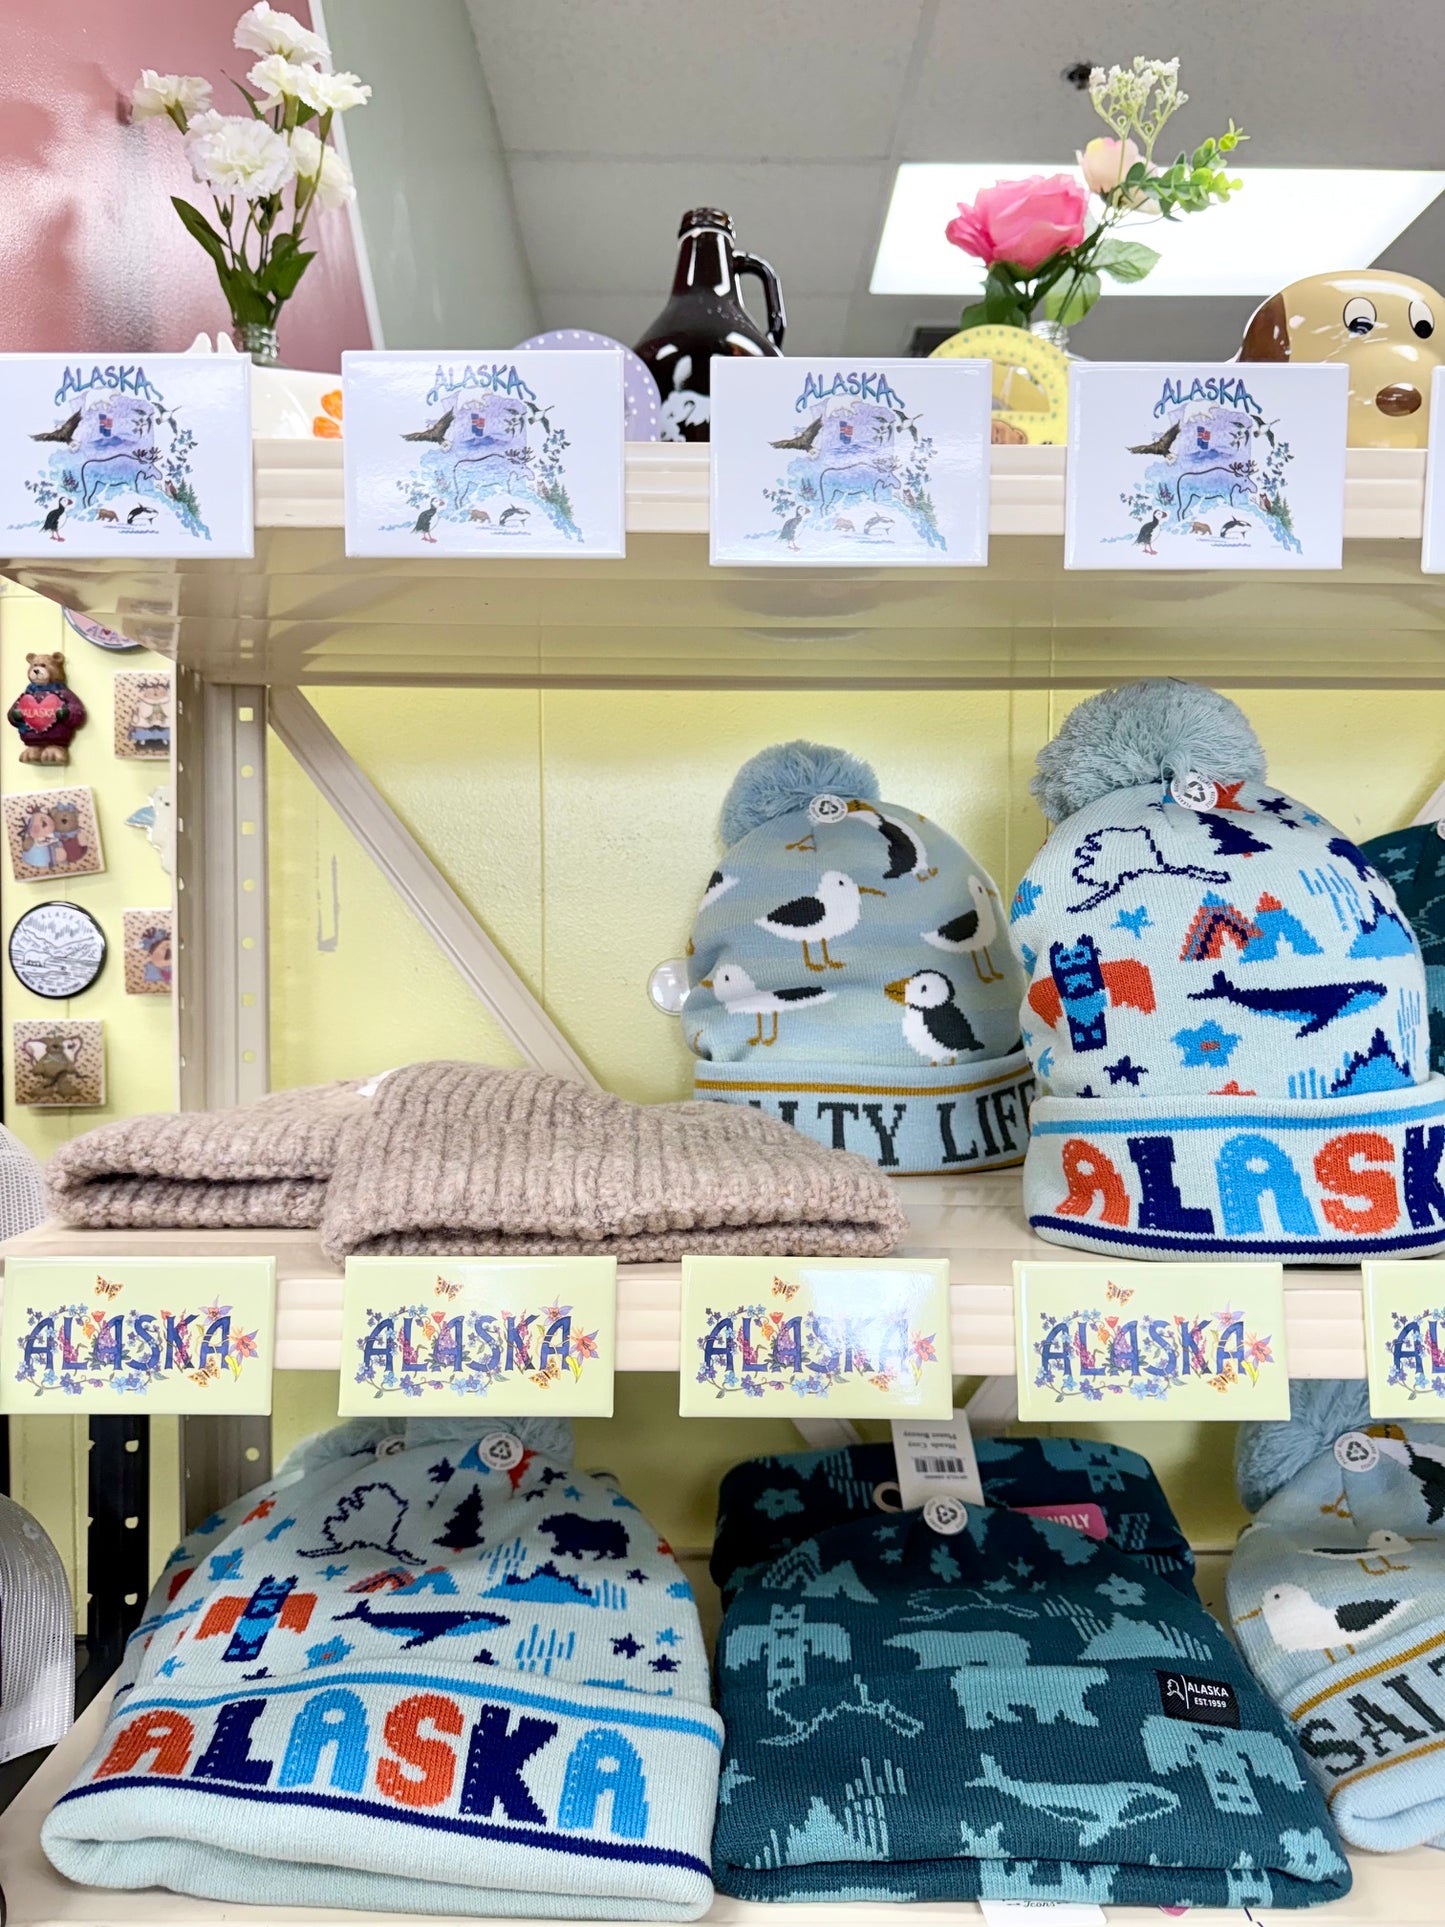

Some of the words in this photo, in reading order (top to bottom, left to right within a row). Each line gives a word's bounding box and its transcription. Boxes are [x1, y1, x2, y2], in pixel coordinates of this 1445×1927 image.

[54, 365, 164, 406] ALASKA
[426, 364, 537, 406] ALASKA
[795, 371, 906, 413] ALASKA
[1153, 377, 1263, 419] ALASKA
[23, 708, 56, 718] ALASKA
[24, 1314, 231, 1371] ALASKA
[364, 1314, 572, 1373] ALASKA
[704, 1315, 909, 1374] ALASKA
[1042, 1319, 1247, 1377] ALASKA
[1188, 1682, 1229, 1697] ALASKA
[1300, 1655, 1445, 1777] SAL
[93, 1688, 649, 1840] ALASKA
